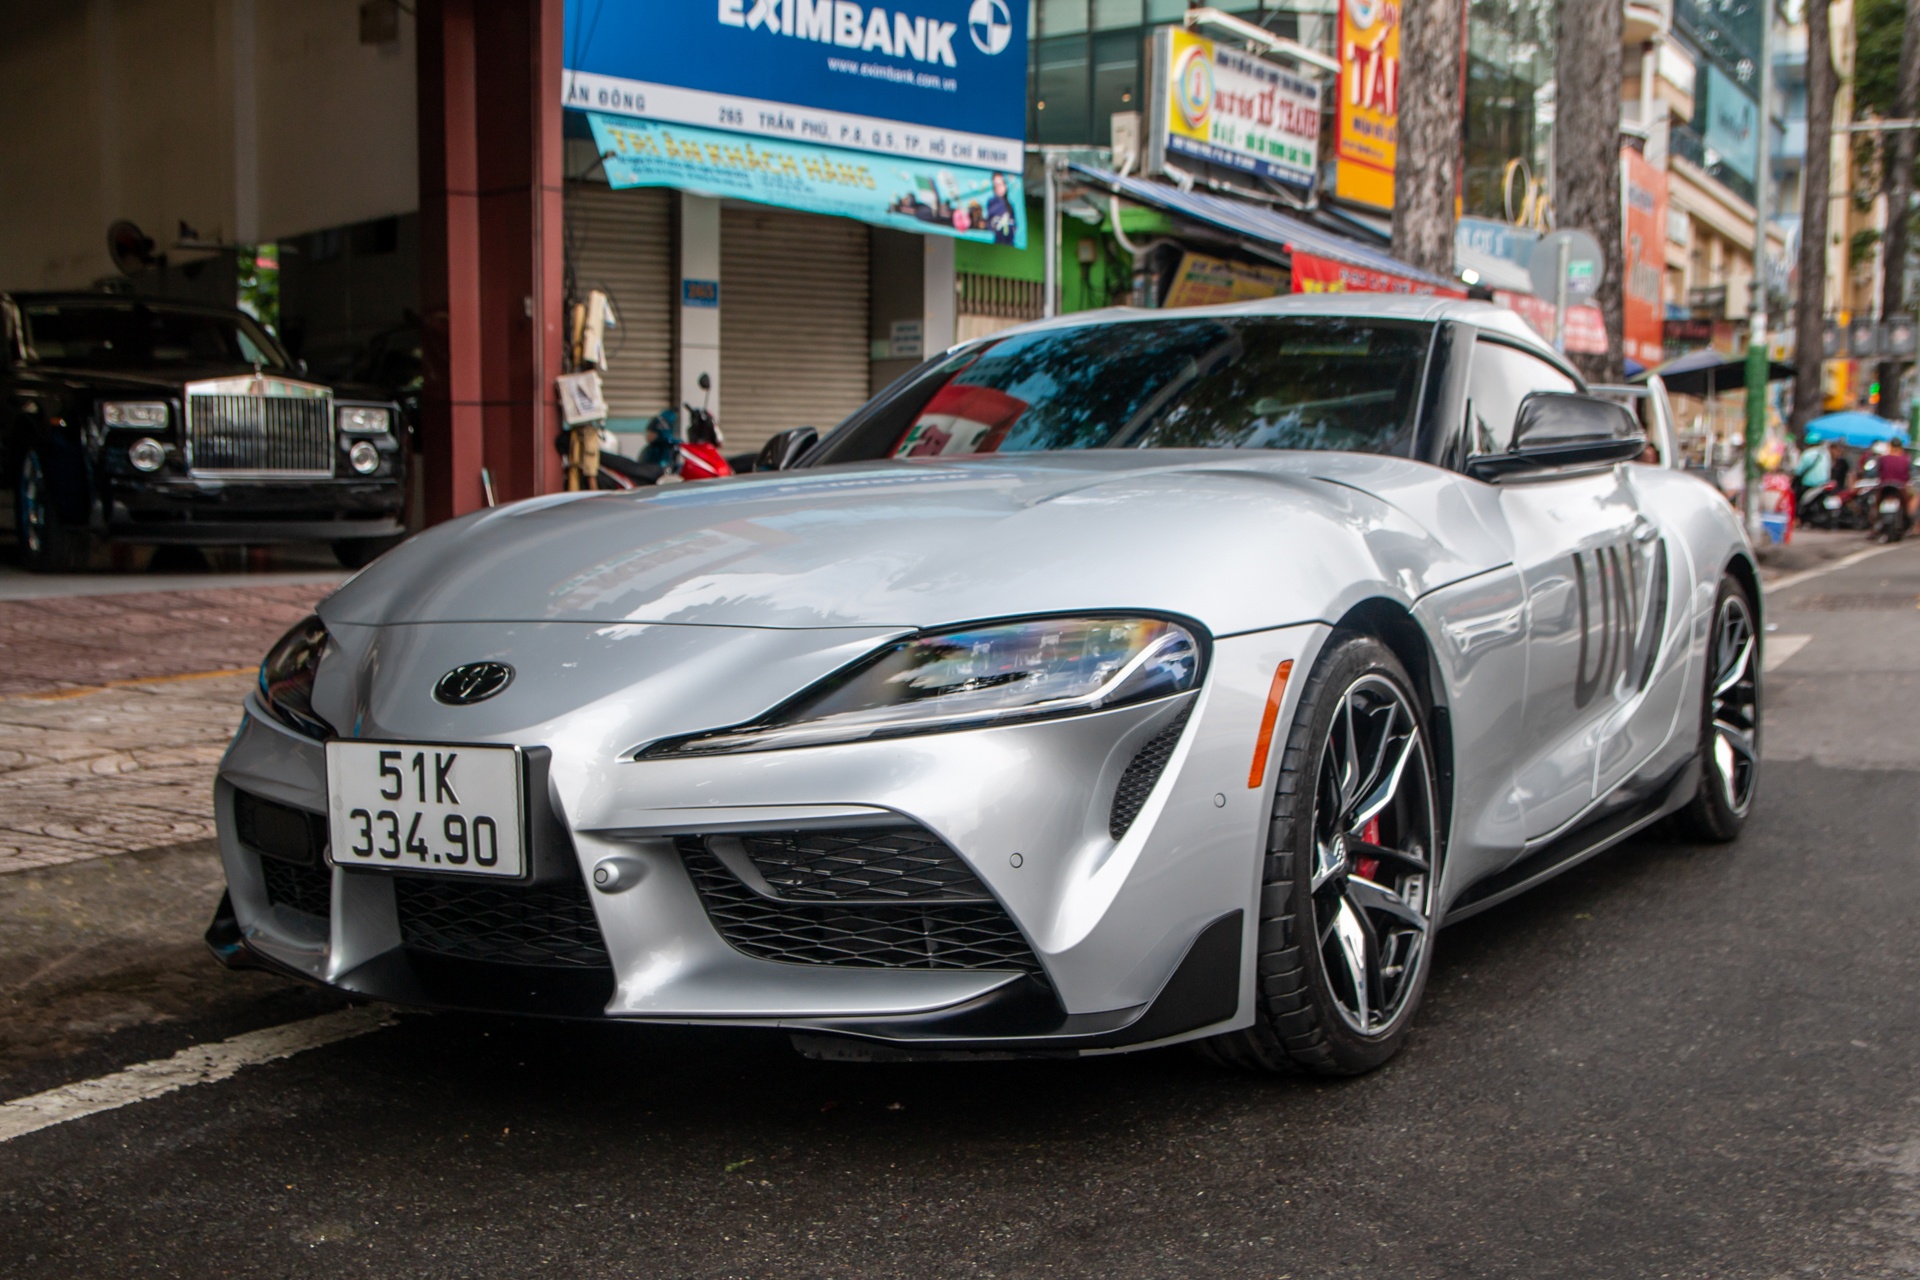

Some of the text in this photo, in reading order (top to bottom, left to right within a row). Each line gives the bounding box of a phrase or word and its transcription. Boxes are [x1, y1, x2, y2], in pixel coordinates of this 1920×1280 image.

[718, 0, 957, 68] EXIMBANK
[827, 57, 957, 92] www.eximbank.com.vn
[607, 126, 660, 158] TRI
[704, 141, 800, 177] KHÁCH
[802, 152, 877, 190] HÀNG
[719, 106, 743, 125] 265
[977, 147, 1009, 165] MINH
[379, 750, 461, 805] 51K
[350, 808, 498, 867] 334.90
